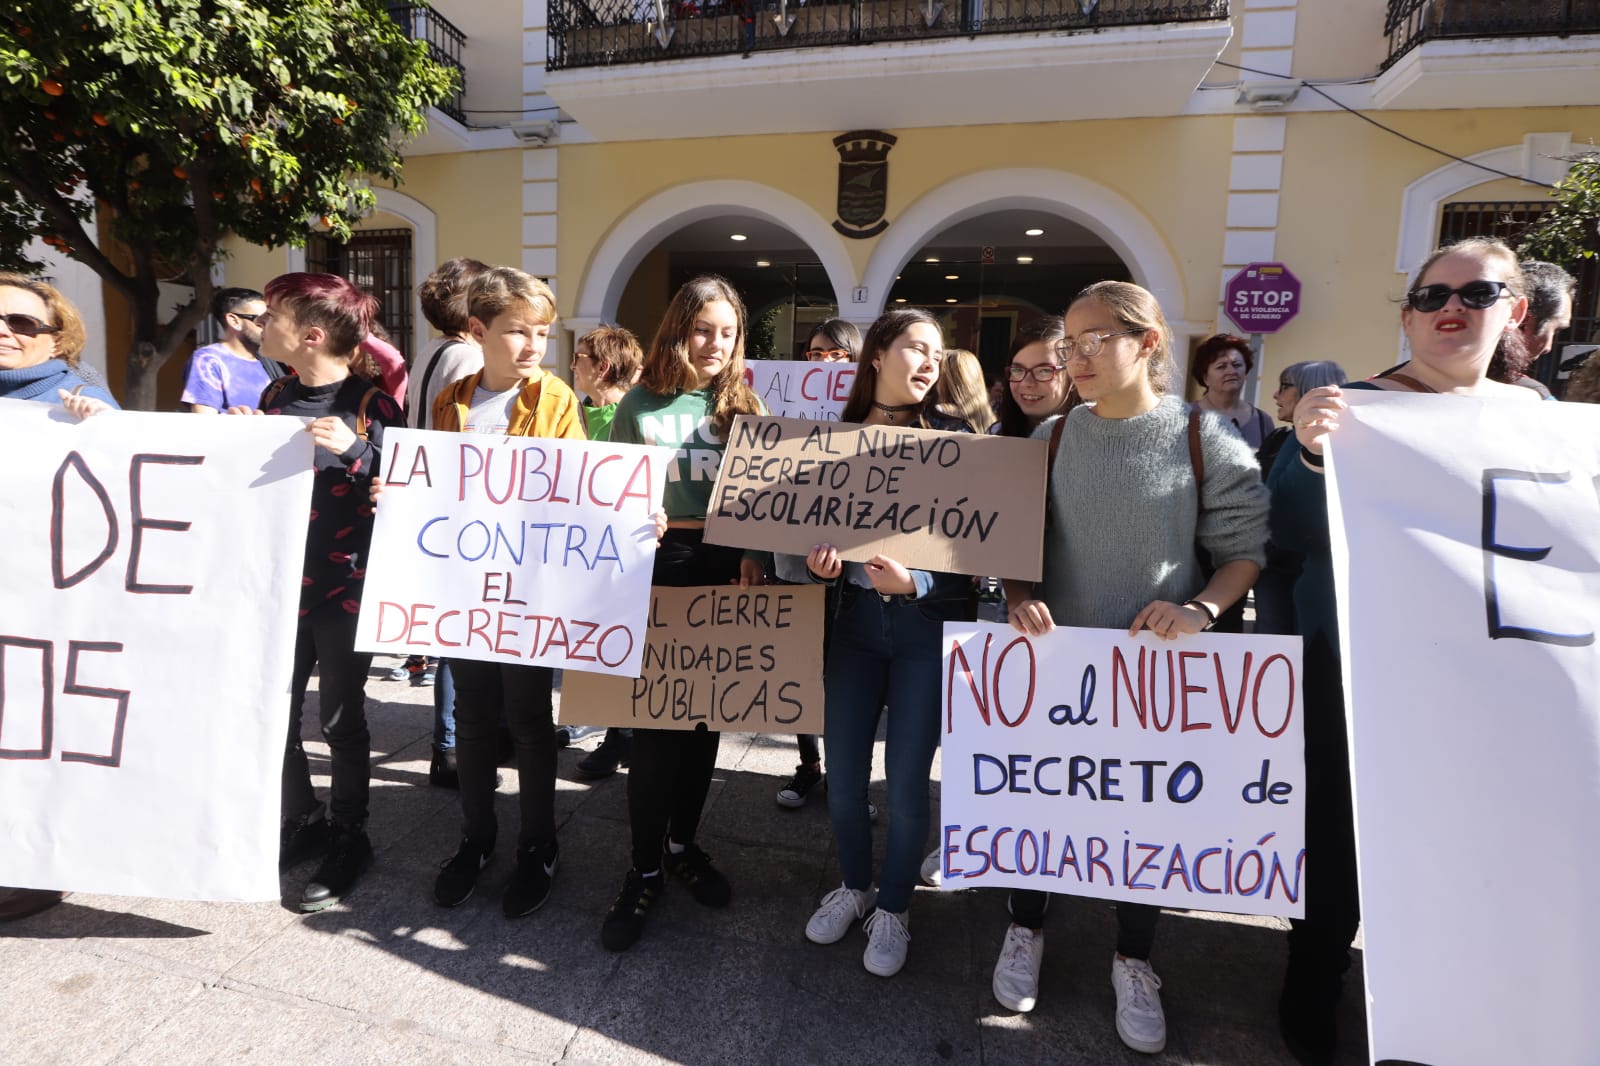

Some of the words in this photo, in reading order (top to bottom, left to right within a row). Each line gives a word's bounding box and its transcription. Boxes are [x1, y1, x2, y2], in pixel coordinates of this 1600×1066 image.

[1235, 291, 1294, 306] STOP
[764, 371, 796, 403] AL
[801, 367, 856, 401] CIE
[667, 449, 726, 482] TR
[736, 422, 782, 451] NO
[801, 425, 841, 455] AL
[856, 430, 961, 468] NUEVO
[385, 442, 432, 488] LA
[459, 437, 652, 516] PÚBLICA
[728, 455, 850, 490] DECRETO
[866, 466, 906, 495] DE
[50, 450, 206, 595] DE
[417, 516, 624, 573] CONTRA
[1482, 468, 1600, 648] E
[482, 571, 527, 606] EL
[647, 596, 668, 629] L
[376, 601, 634, 668] DECRETAZO
[947, 632, 1036, 734] NO
[1048, 663, 1098, 726] al
[1112, 645, 1295, 738] NUEVO
[972, 753, 1204, 804] DECRETO
[1242, 759, 1293, 805] de
